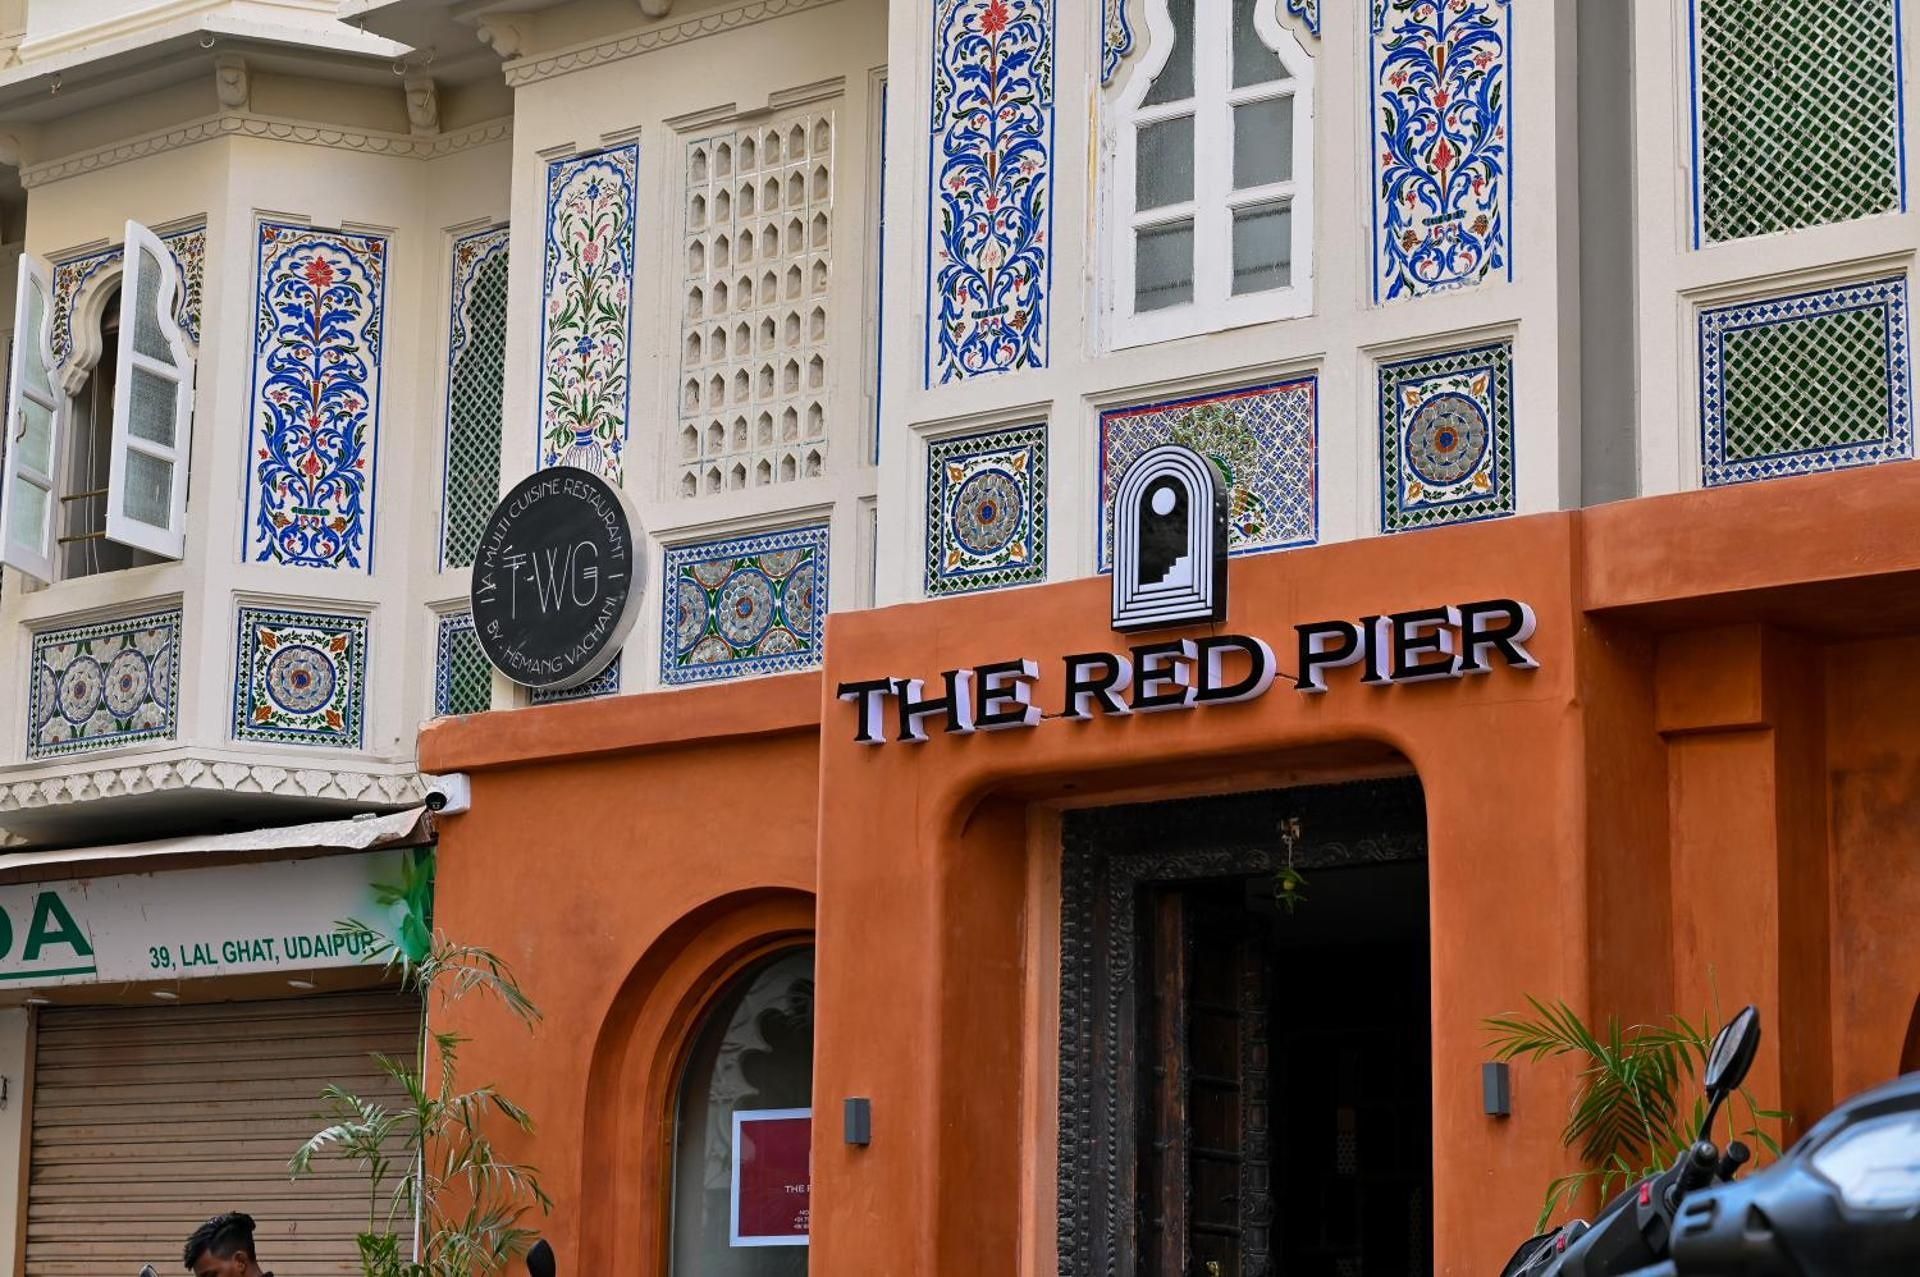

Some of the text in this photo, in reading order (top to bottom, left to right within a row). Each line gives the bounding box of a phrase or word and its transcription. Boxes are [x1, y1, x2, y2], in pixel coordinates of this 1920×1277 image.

[484, 516, 511, 568] MULTI
[508, 478, 560, 518] CUISINE
[562, 477, 624, 561] RESTAURANT
[487, 596, 617, 676] BY HEMANG VACHANI
[836, 598, 1540, 745] THE RED PIER
[149, 946, 177, 971] 39,
[181, 942, 218, 967] LAL
[223, 937, 279, 964] GHAT,
[784, 1185, 805, 1193] THE
